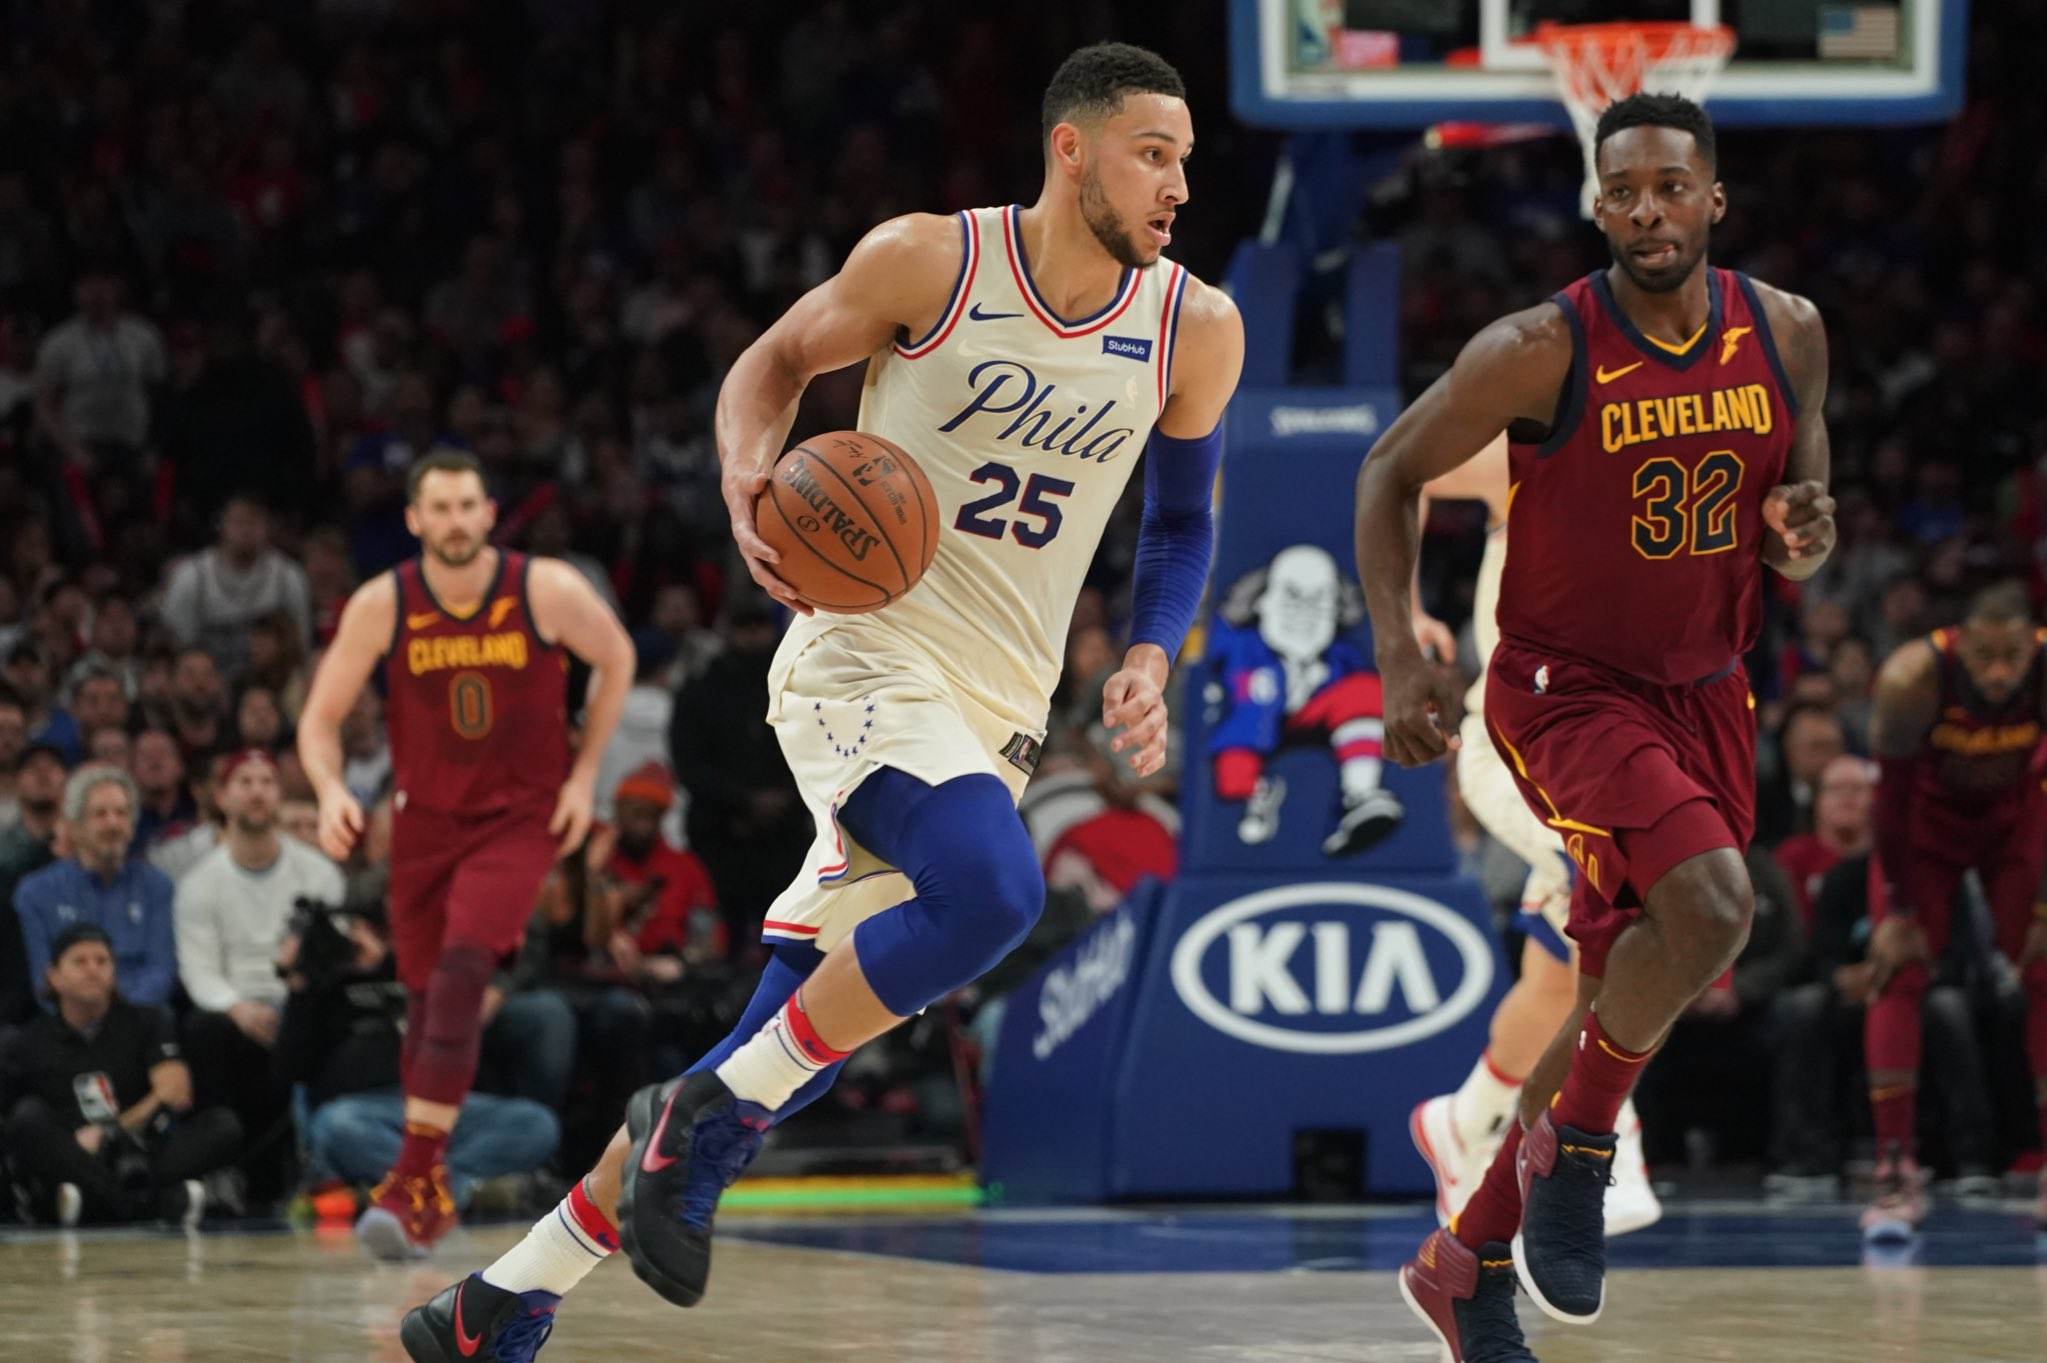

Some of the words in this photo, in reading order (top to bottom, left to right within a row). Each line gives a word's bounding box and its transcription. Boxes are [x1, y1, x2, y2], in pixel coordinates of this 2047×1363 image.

[1107, 340, 1146, 356] StubHub
[938, 360, 1135, 464] Phila
[1601, 383, 1772, 454] CLEVELAND
[781, 455, 880, 562] SPALDING
[954, 461, 1076, 550] 25
[1631, 450, 1745, 560] 32
[448, 669, 495, 740] 0
[1228, 919, 1439, 1016] KIA
